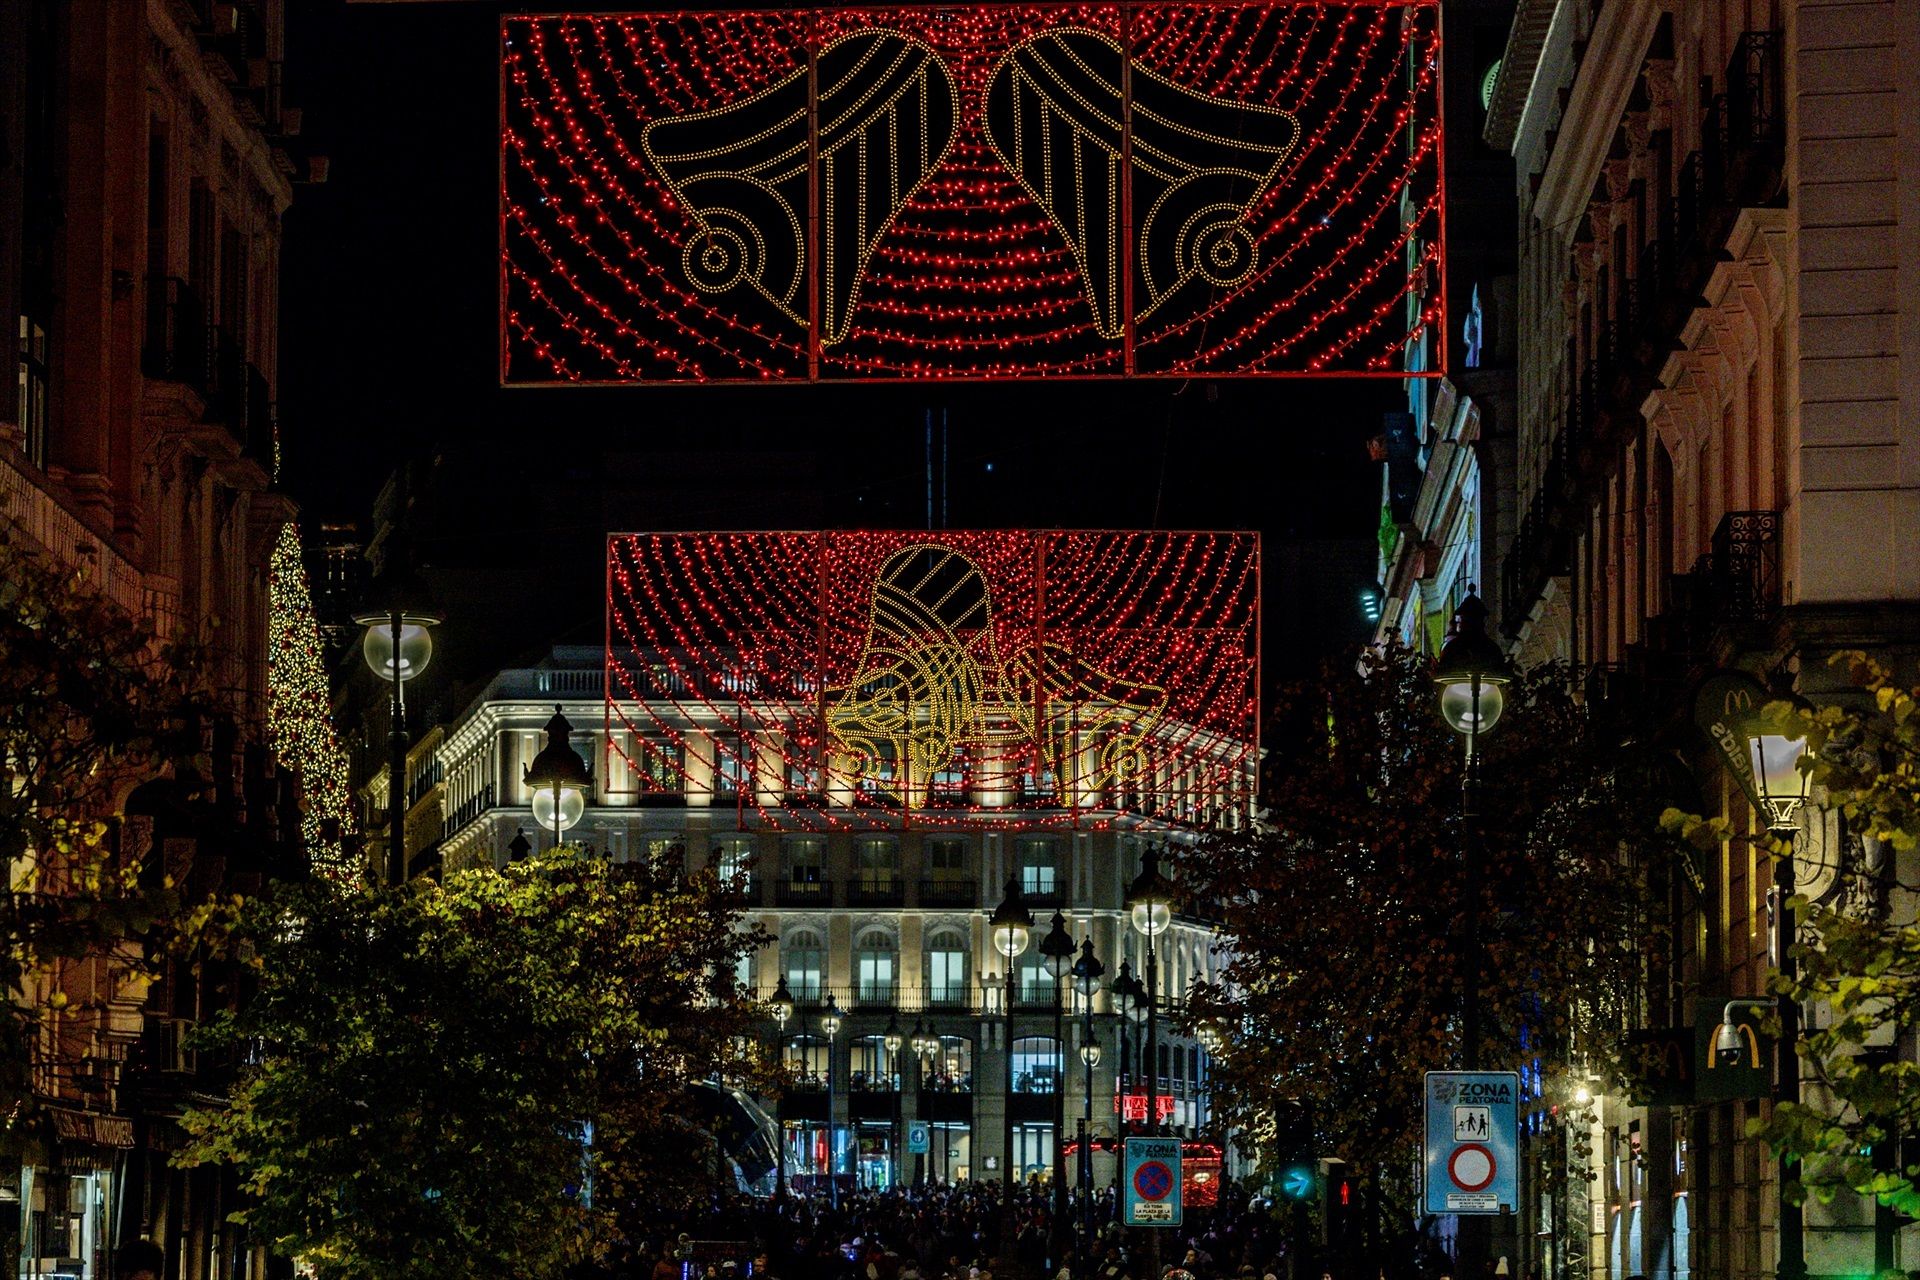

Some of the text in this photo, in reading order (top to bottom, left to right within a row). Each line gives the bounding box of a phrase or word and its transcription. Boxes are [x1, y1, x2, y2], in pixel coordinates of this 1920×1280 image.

[1459, 1083, 1511, 1096] ZONA
[1459, 1097, 1511, 1105] PEATONAL
[1146, 1144, 1178, 1153] ZONA
